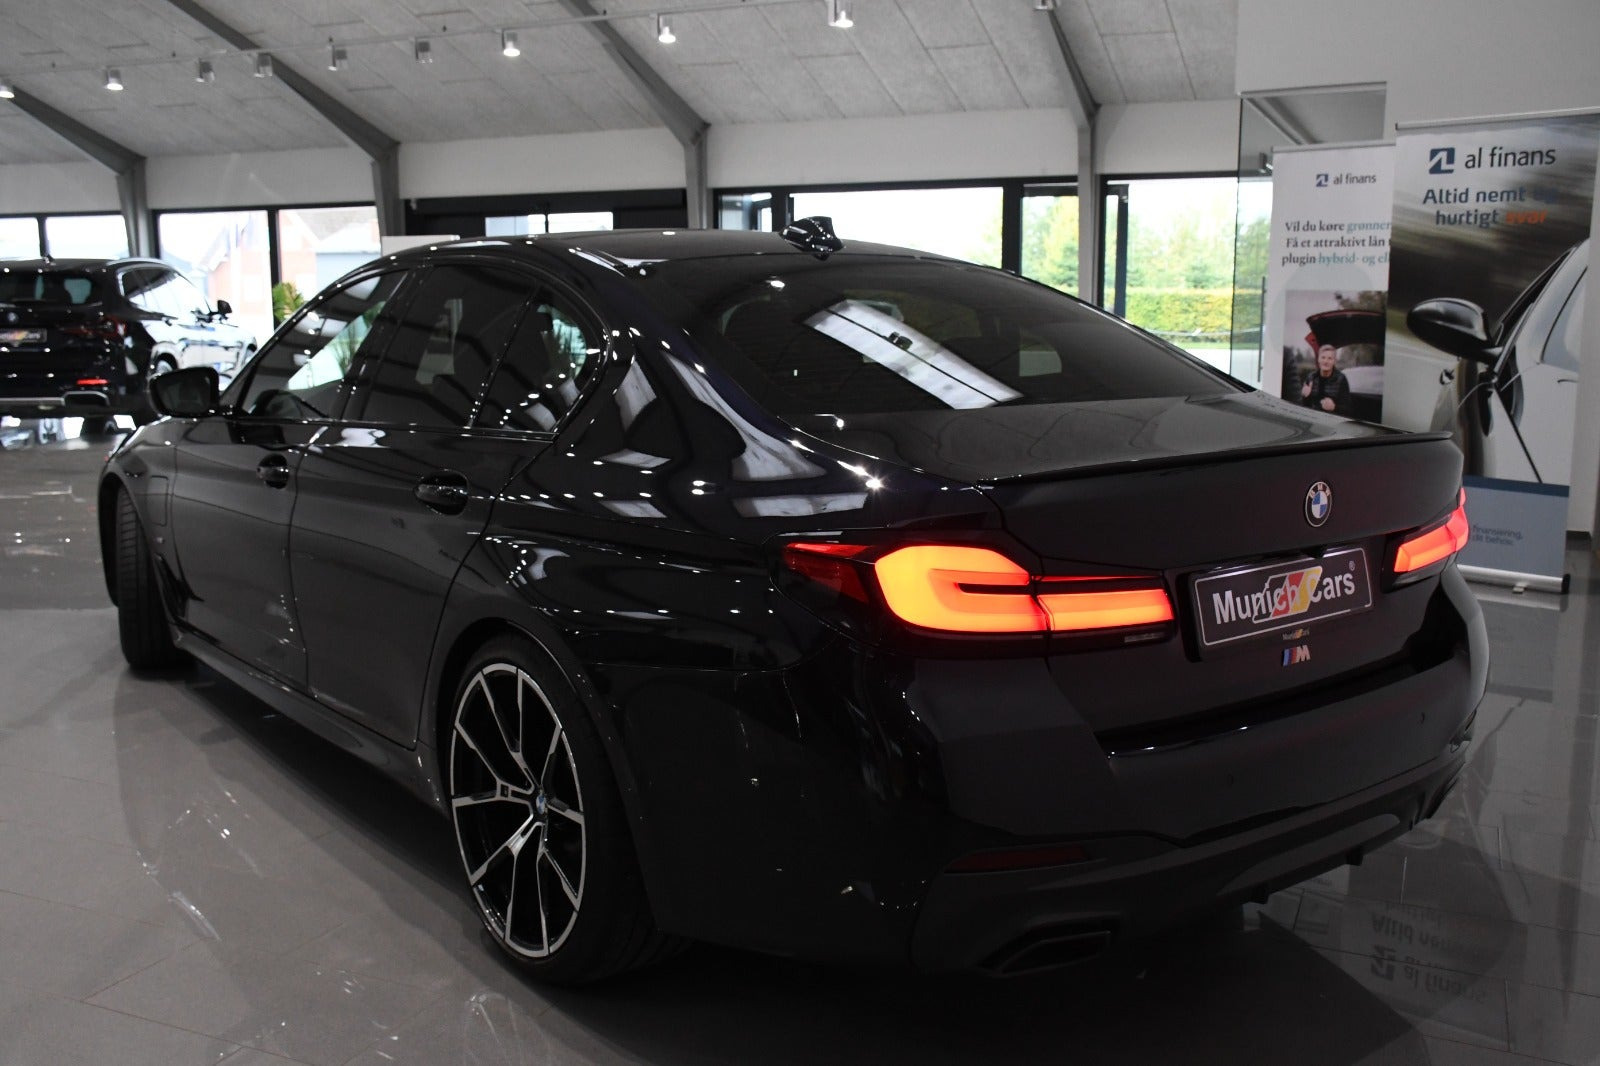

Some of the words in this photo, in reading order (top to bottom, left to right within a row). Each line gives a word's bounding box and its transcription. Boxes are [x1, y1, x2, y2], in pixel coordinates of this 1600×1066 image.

[1464, 147, 1482, 169] al
[1489, 146, 1556, 168] finans
[1333, 173, 1343, 185] al
[1345, 173, 1377, 185] finans
[1422, 187, 1469, 205] Altid
[1475, 186, 1527, 203] nemt
[1284, 221, 1300, 232] Vil
[1302, 220, 1317, 232] du
[1319, 220, 1345, 232] køre
[1435, 209, 1499, 229] hurtigt
[1286, 236, 1299, 248] Få
[1300, 238, 1311, 248] et
[1313, 236, 1366, 248] attraktivt
[1368, 235, 1385, 247] lån
[1361, 255, 1376, 267] og
[1212, 579, 1300, 625] Munich
